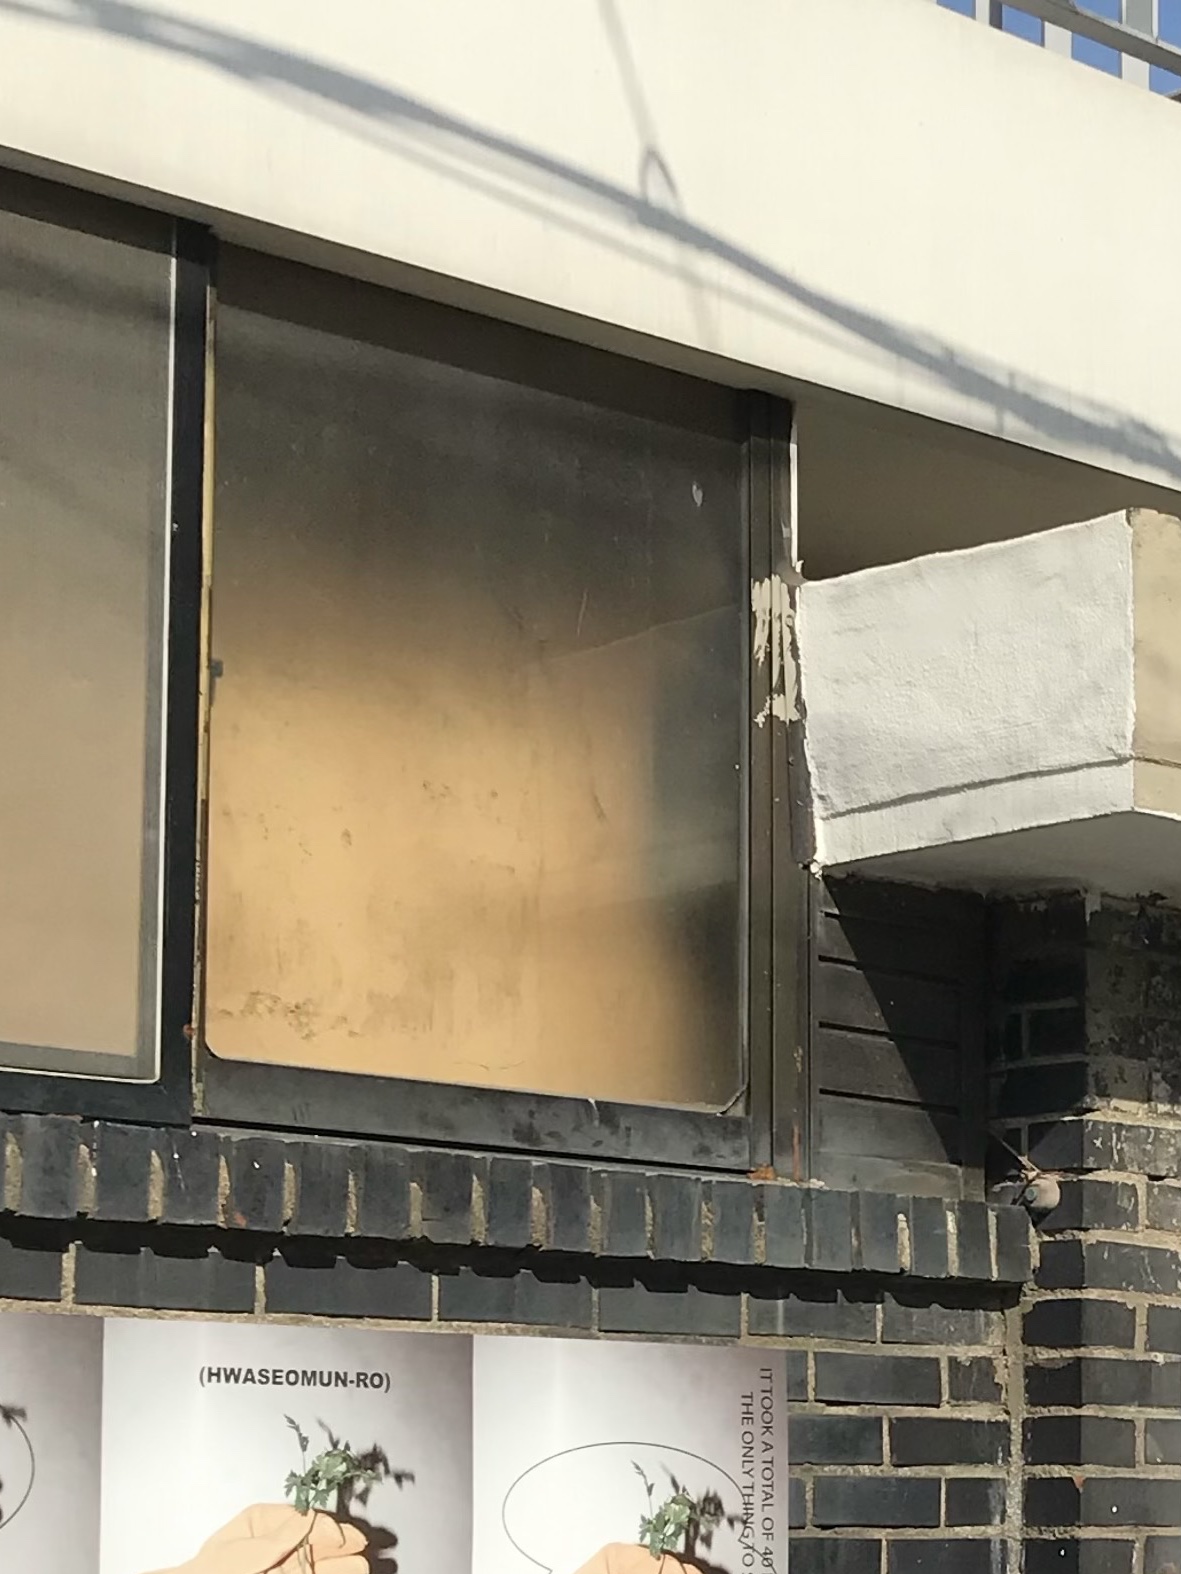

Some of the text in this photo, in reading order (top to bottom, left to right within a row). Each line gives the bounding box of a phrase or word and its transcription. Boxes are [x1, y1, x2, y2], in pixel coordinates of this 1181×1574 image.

[199, 1366, 391, 1394] (HWASEOMUN-RO)
[760, 1368, 772, 1383] IT
[740, 1391, 754, 1426] THE
[760, 1386, 774, 1436] TOOK
[741, 1430, 755, 1479] ONLY
[761, 1440, 774, 1453] A
[761, 1456, 775, 1512] TOTAL
[742, 1482, 756, 1539] THING
[761, 1517, 775, 1541] OF
[742, 1541, 755, 1567] TO
